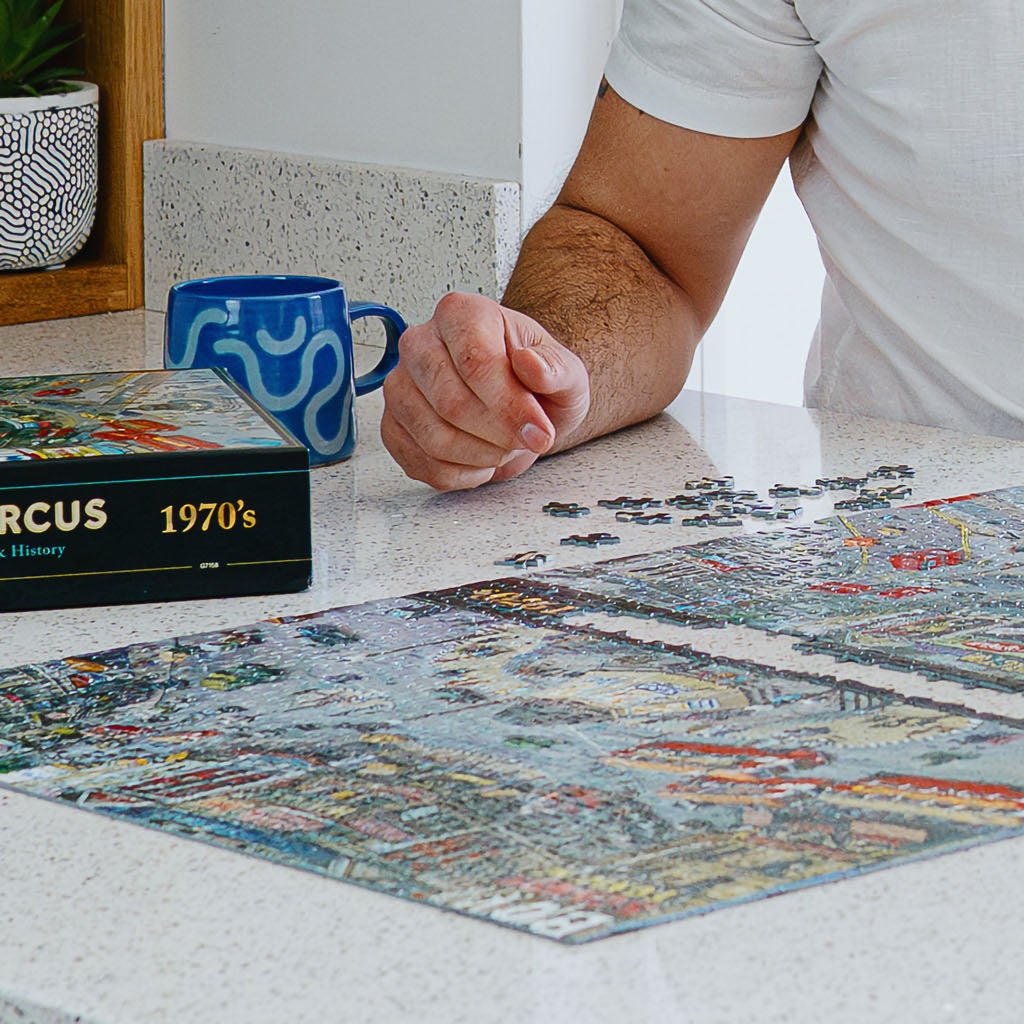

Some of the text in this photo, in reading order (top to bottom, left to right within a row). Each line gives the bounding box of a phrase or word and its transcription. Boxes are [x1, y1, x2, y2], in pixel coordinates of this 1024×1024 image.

[0, 498, 108, 535] RCUS
[160, 499, 257, 534] 1970's
[11, 544, 66, 559] History
